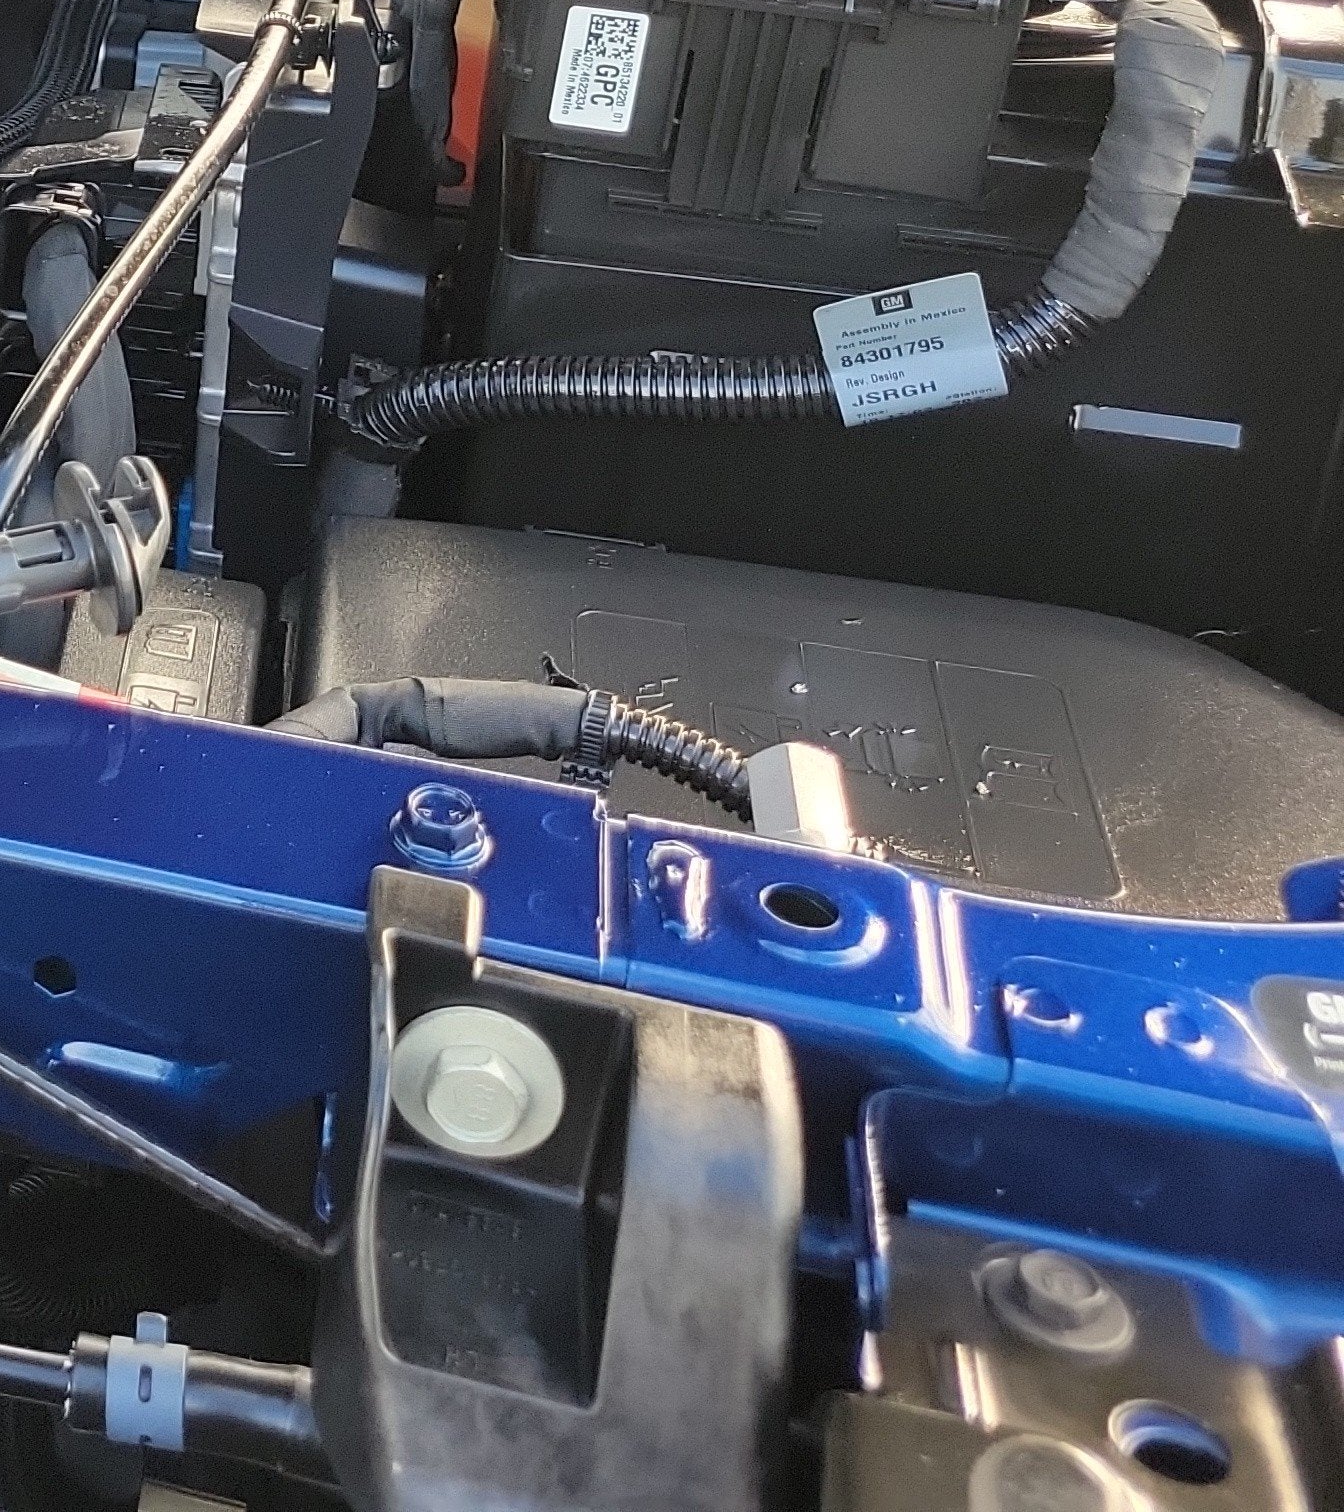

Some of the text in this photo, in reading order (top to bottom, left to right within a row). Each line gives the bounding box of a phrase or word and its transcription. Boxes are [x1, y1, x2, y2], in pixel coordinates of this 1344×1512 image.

[570, 48, 583, 71] Made
[562, 85, 574, 115] Mexico
[590, 64, 620, 108] GPC
[880, 294, 905, 311] GM
[841, 321, 901, 339] Assembly
[921, 306, 967, 322] Mexico
[835, 333, 898, 351] Part Number
[840, 336, 945, 369] 84301795
[871, 369, 906, 384] Design
[851, 380, 938, 408] JSRGH
